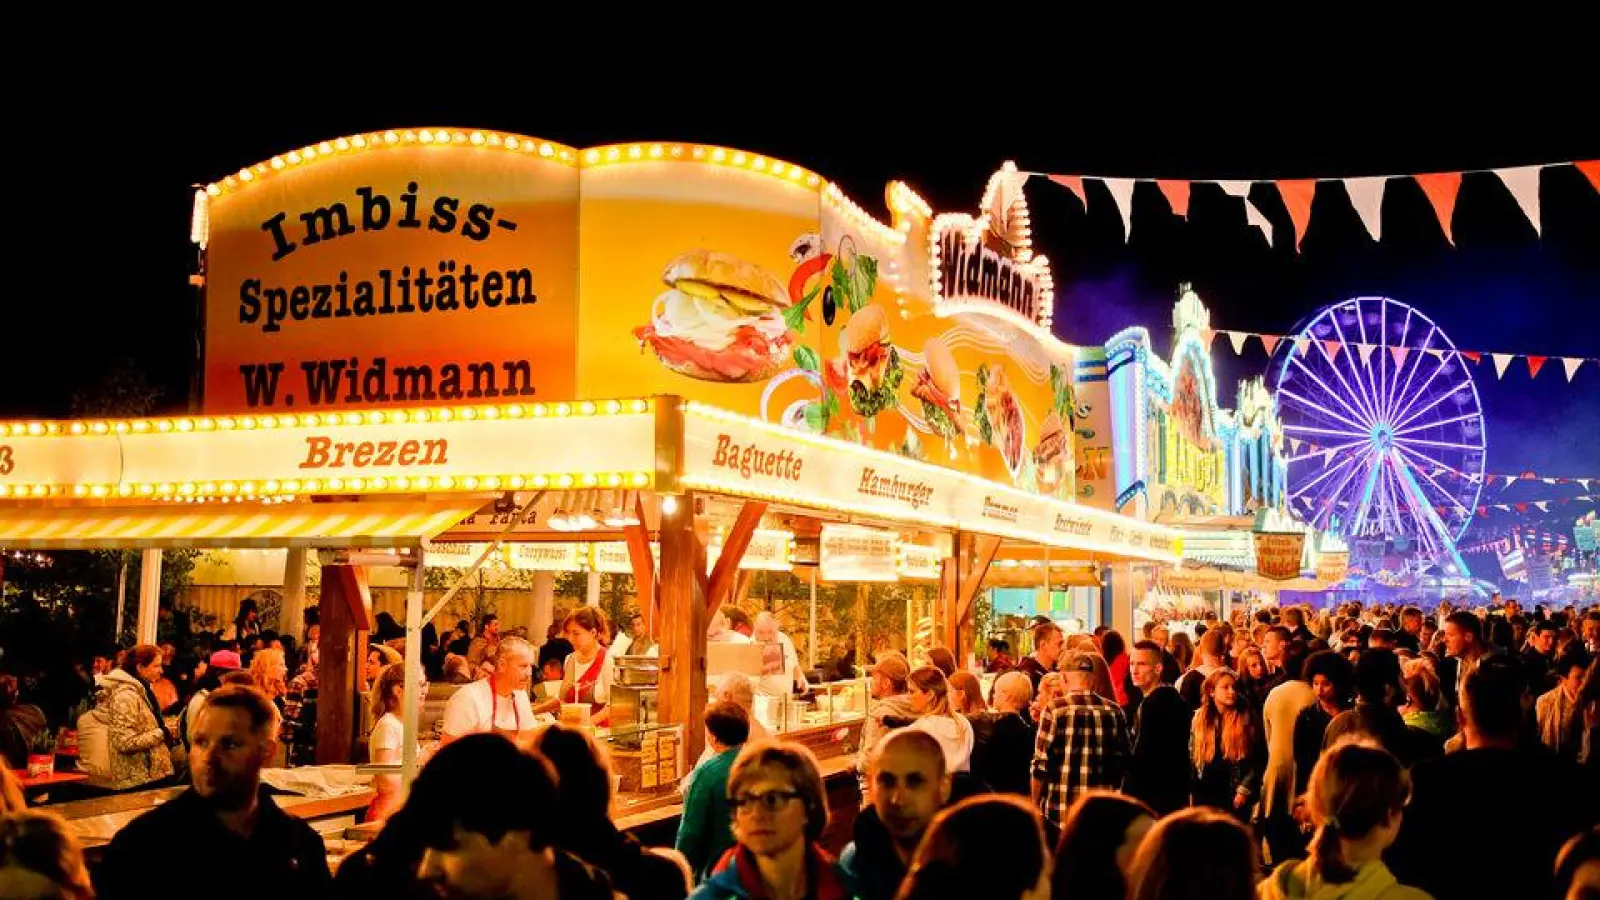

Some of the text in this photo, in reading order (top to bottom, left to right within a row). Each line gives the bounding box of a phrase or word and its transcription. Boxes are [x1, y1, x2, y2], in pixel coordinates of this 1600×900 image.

[261, 181, 518, 261] Imbiss-
[239, 260, 537, 333] Spezialitäten
[940, 229, 1034, 320] Widmann
[298, 436, 448, 469] Brezen
[712, 433, 803, 481] Baguette
[858, 466, 934, 509] Hamburger
